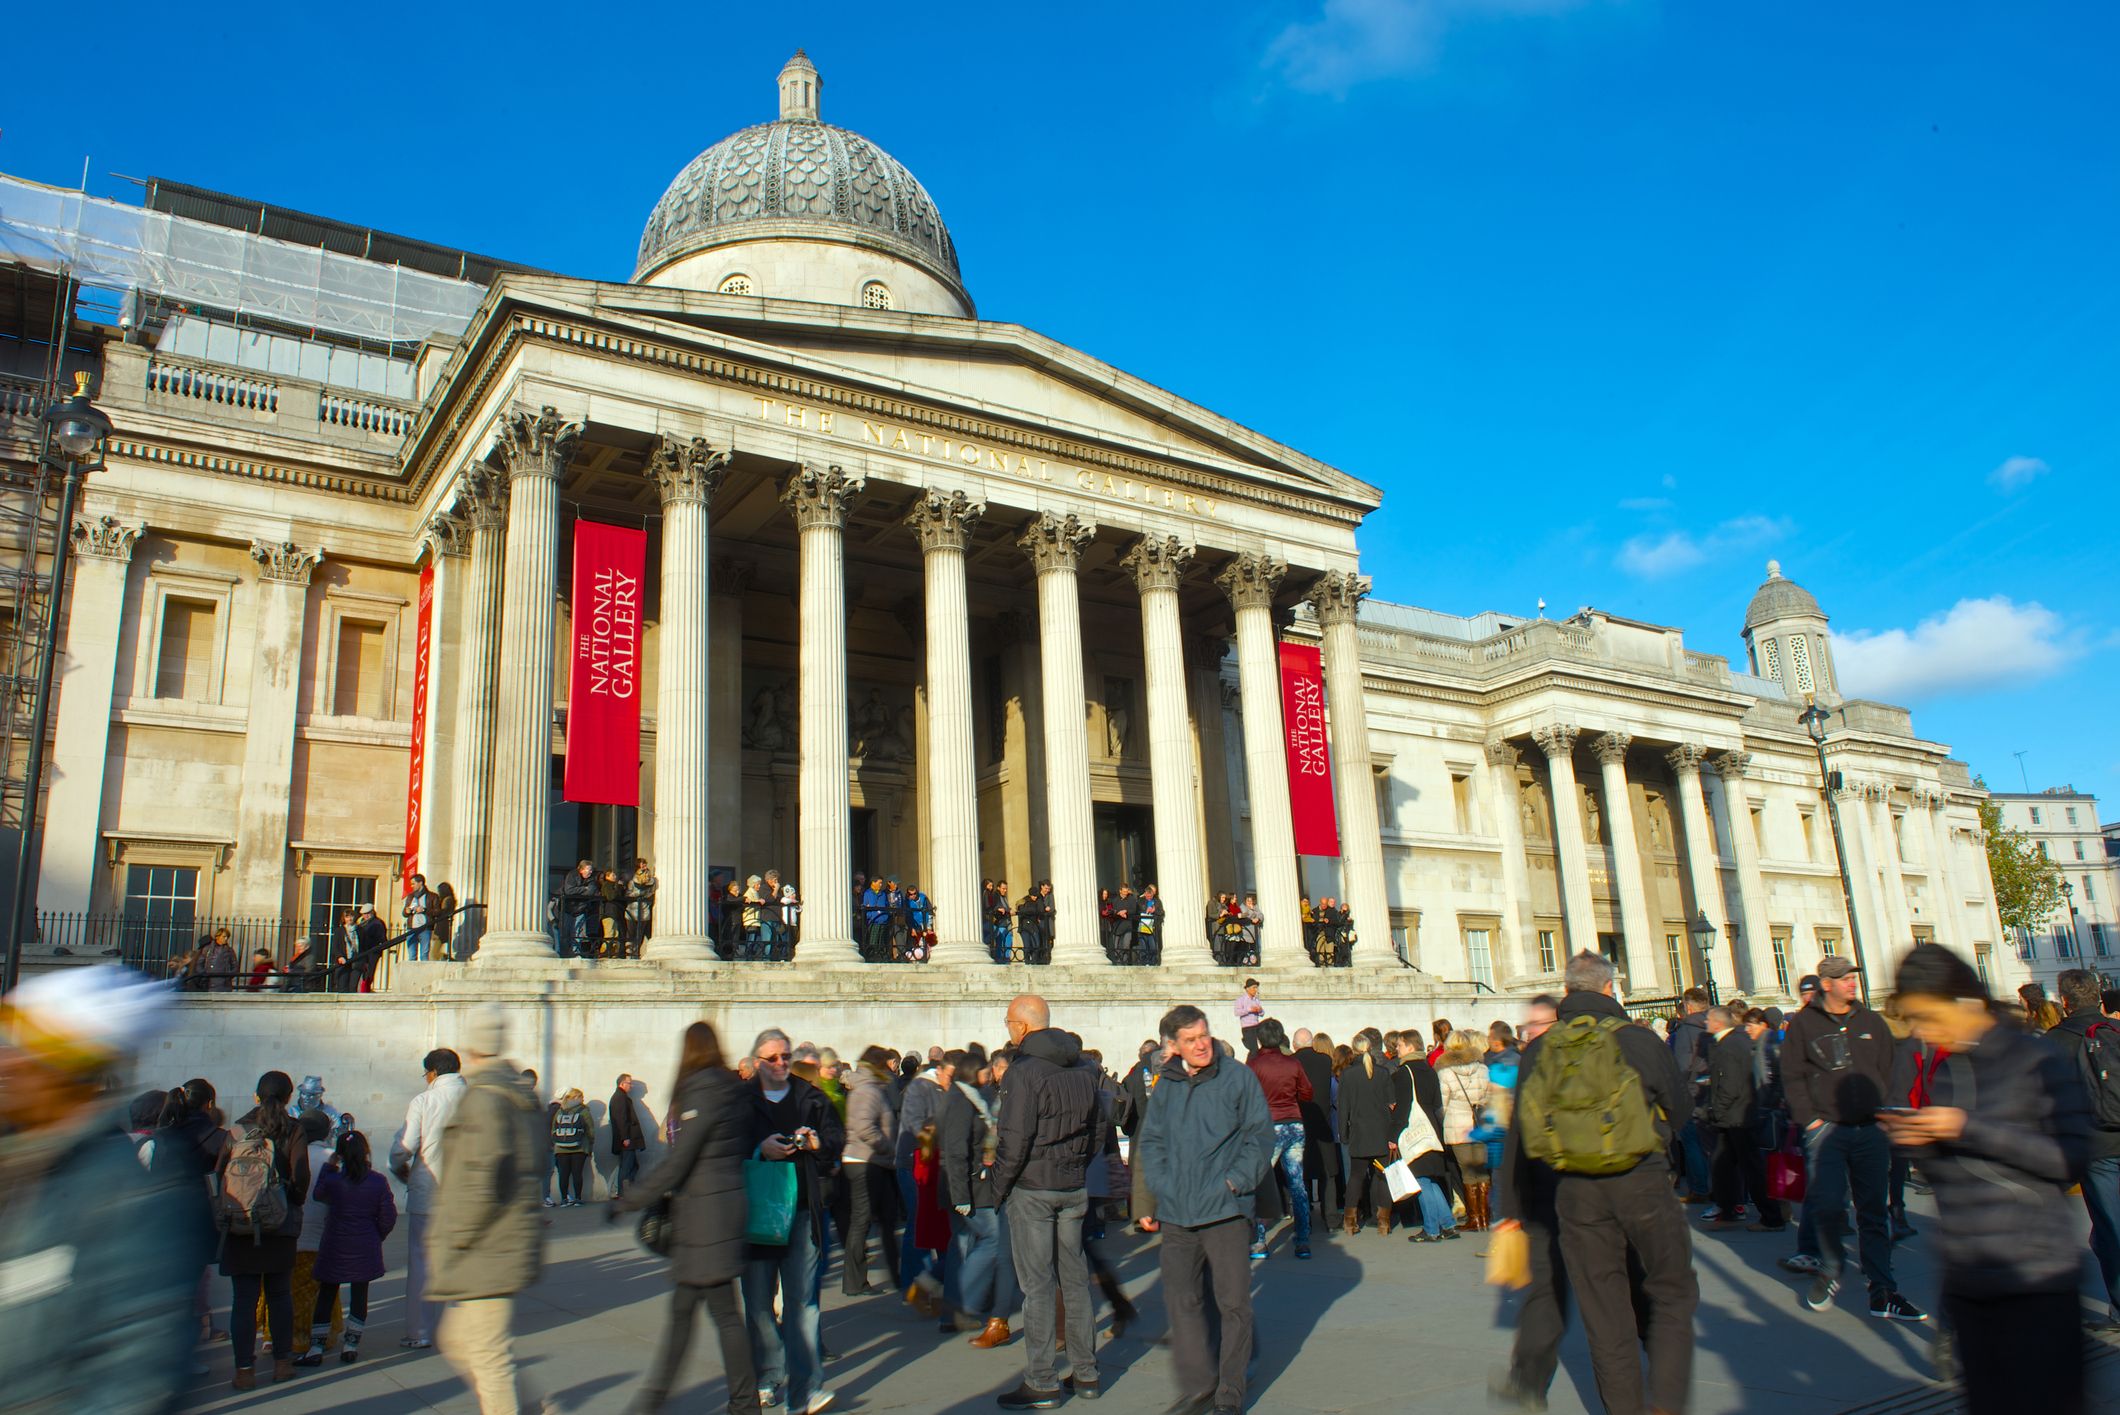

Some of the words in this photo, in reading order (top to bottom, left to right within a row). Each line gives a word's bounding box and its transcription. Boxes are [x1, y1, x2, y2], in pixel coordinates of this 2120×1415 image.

[754, 397, 834, 434] THE
[864, 420, 1053, 481] NATIONAL
[1077, 470, 1217, 519] GALLERY
[579, 633, 590, 659] THE
[590, 567, 613, 696] NATIONAL
[611, 569, 637, 699] GALLERY
[410, 621, 429, 837] WELCOME
[1290, 728, 1298, 748] THE
[1293, 676, 1312, 775] NATIONAL
[1306, 678, 1326, 776] GALLERY
